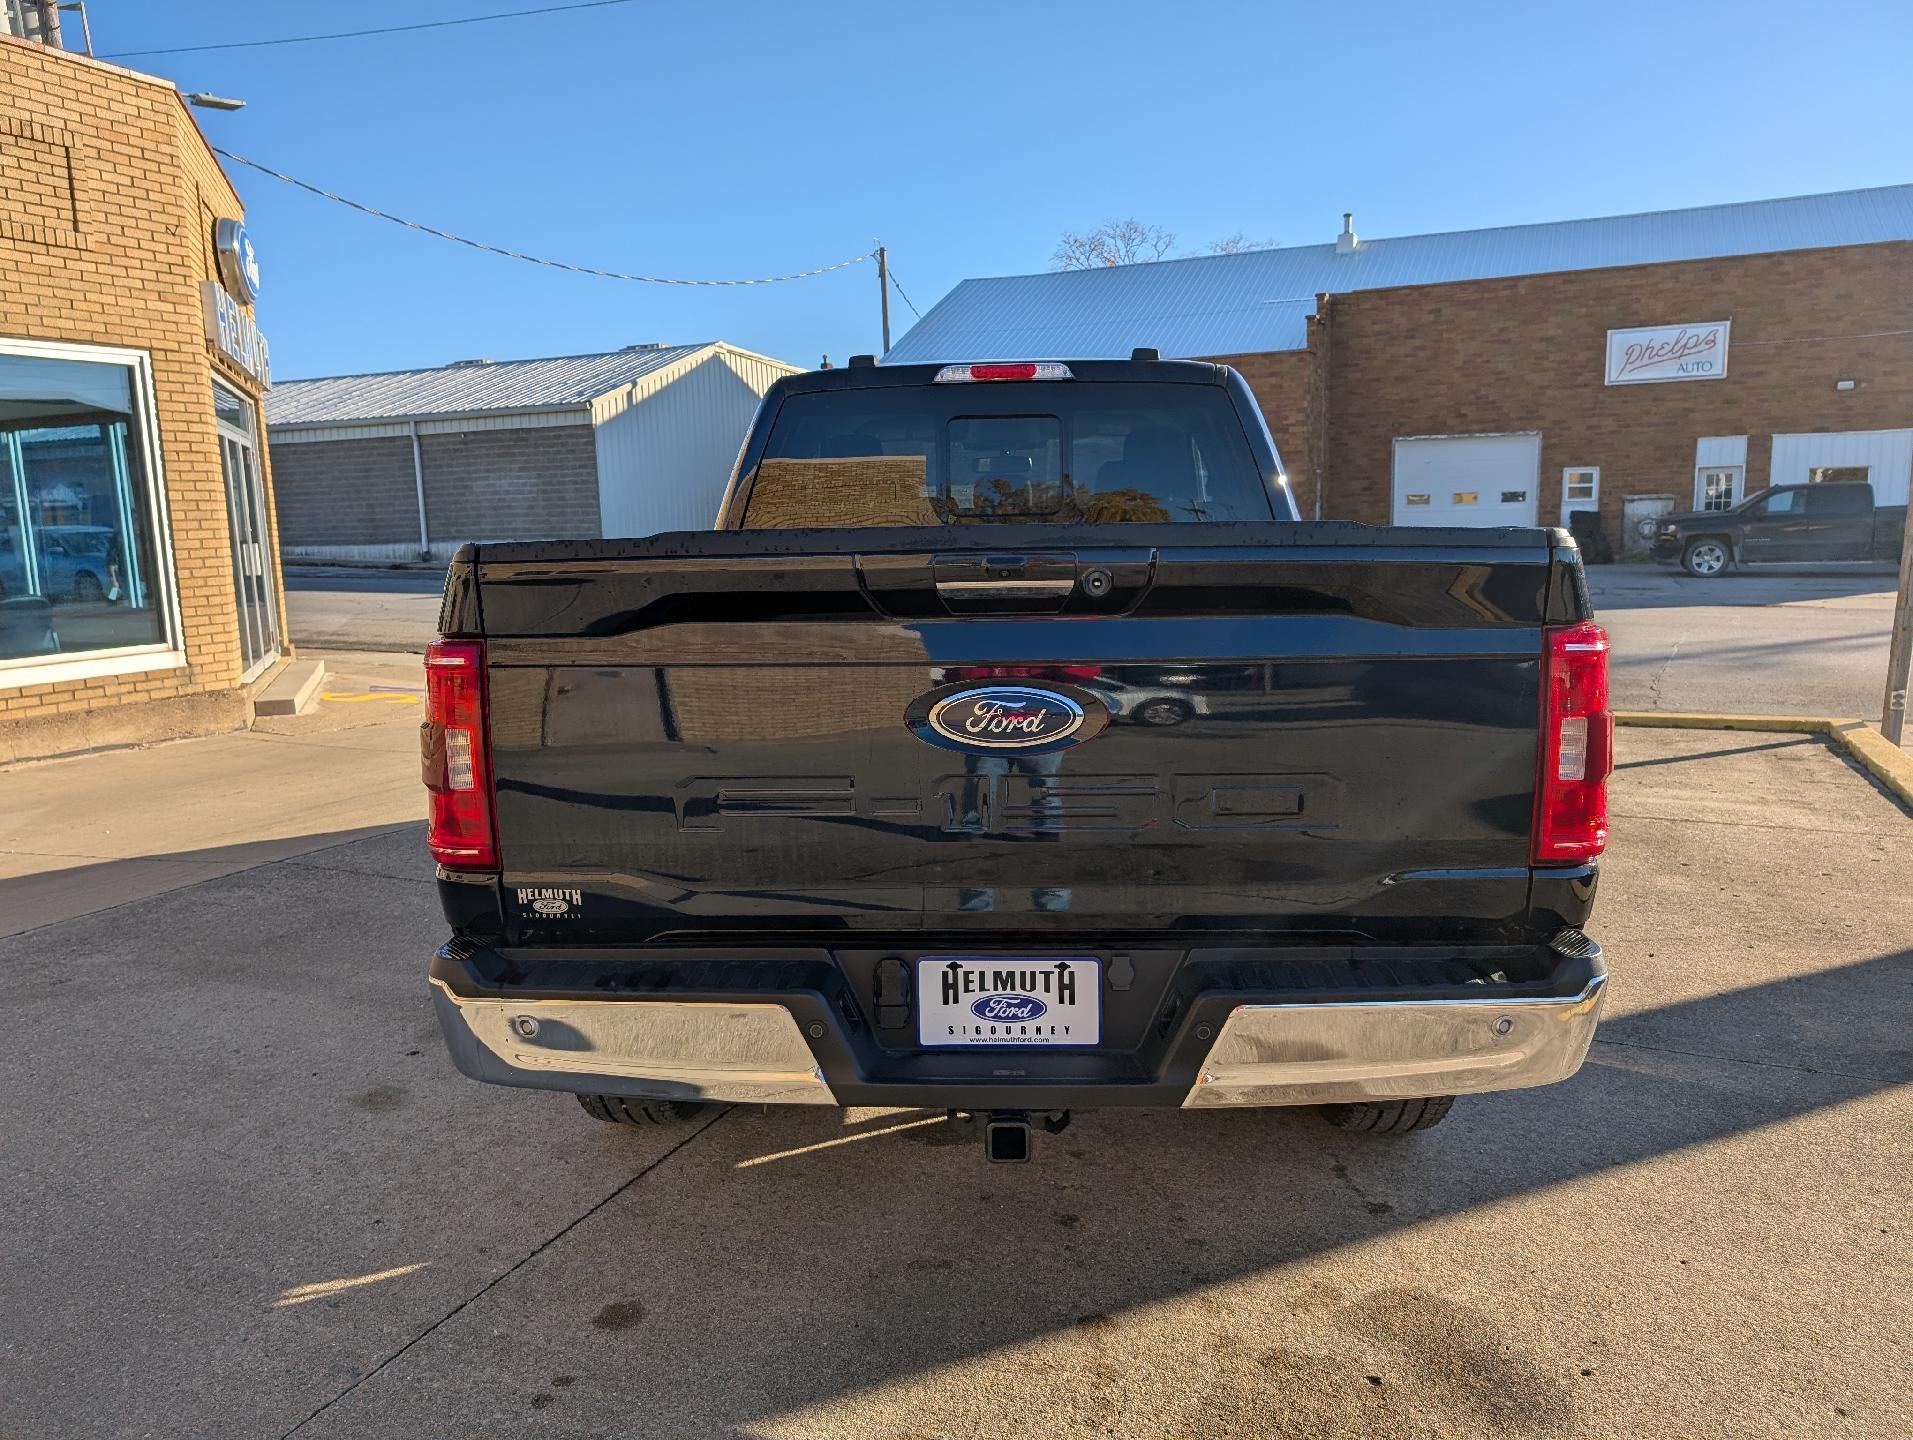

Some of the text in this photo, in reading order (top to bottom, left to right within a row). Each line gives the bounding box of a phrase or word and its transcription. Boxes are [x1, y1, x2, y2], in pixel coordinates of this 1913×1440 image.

[1616, 328, 1720, 380] Phelps
[1676, 360, 1713, 374] AUTO
[965, 699, 1047, 734] Ford
[517, 888, 582, 906] HELMUTH
[942, 968, 1076, 1006] HELMUTH
[985, 997, 1033, 1019] Ford
[948, 1025, 1071, 1036] SIGOURNEY
[969, 1036, 1050, 1044] www.helmuthford.com
